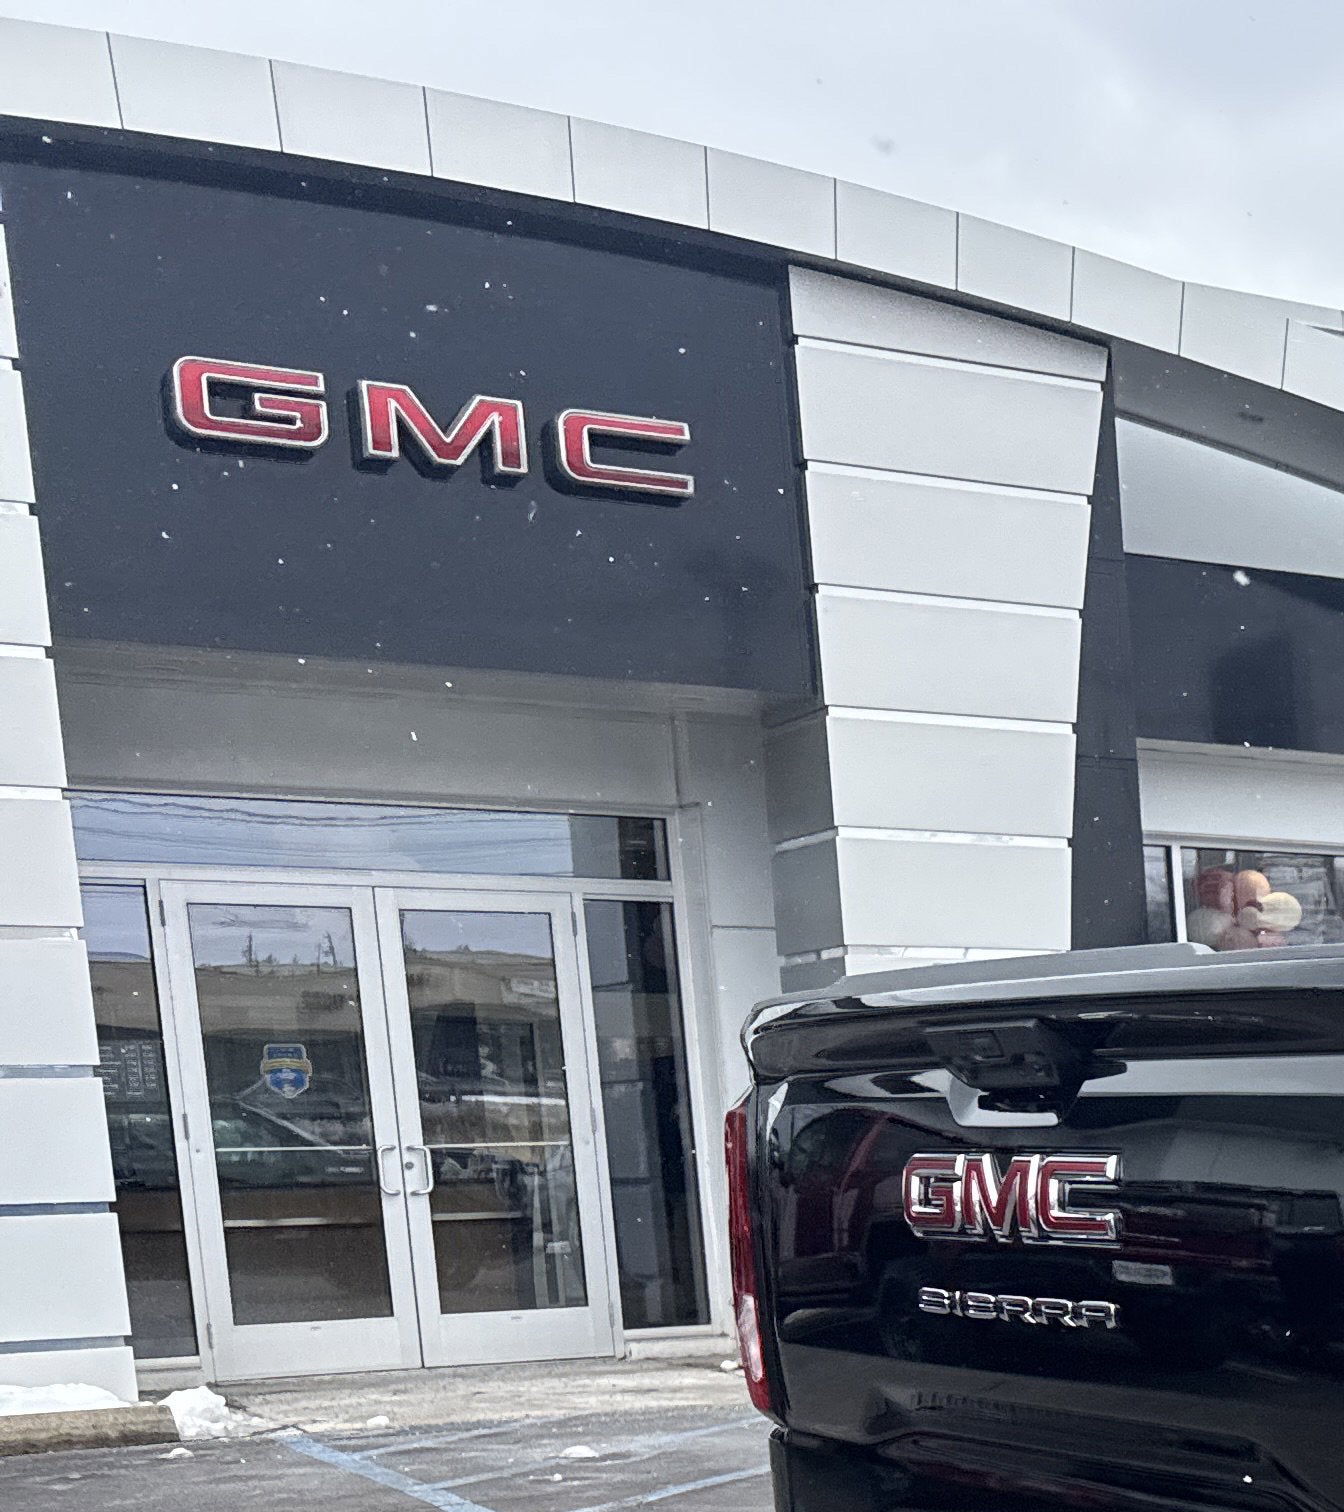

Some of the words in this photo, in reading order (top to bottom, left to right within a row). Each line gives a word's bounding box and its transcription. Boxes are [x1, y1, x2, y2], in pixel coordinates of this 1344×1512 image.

[171, 355, 696, 499] GMC
[902, 1152, 1124, 1249] GMC
[918, 1287, 1121, 1328] SIERRA
